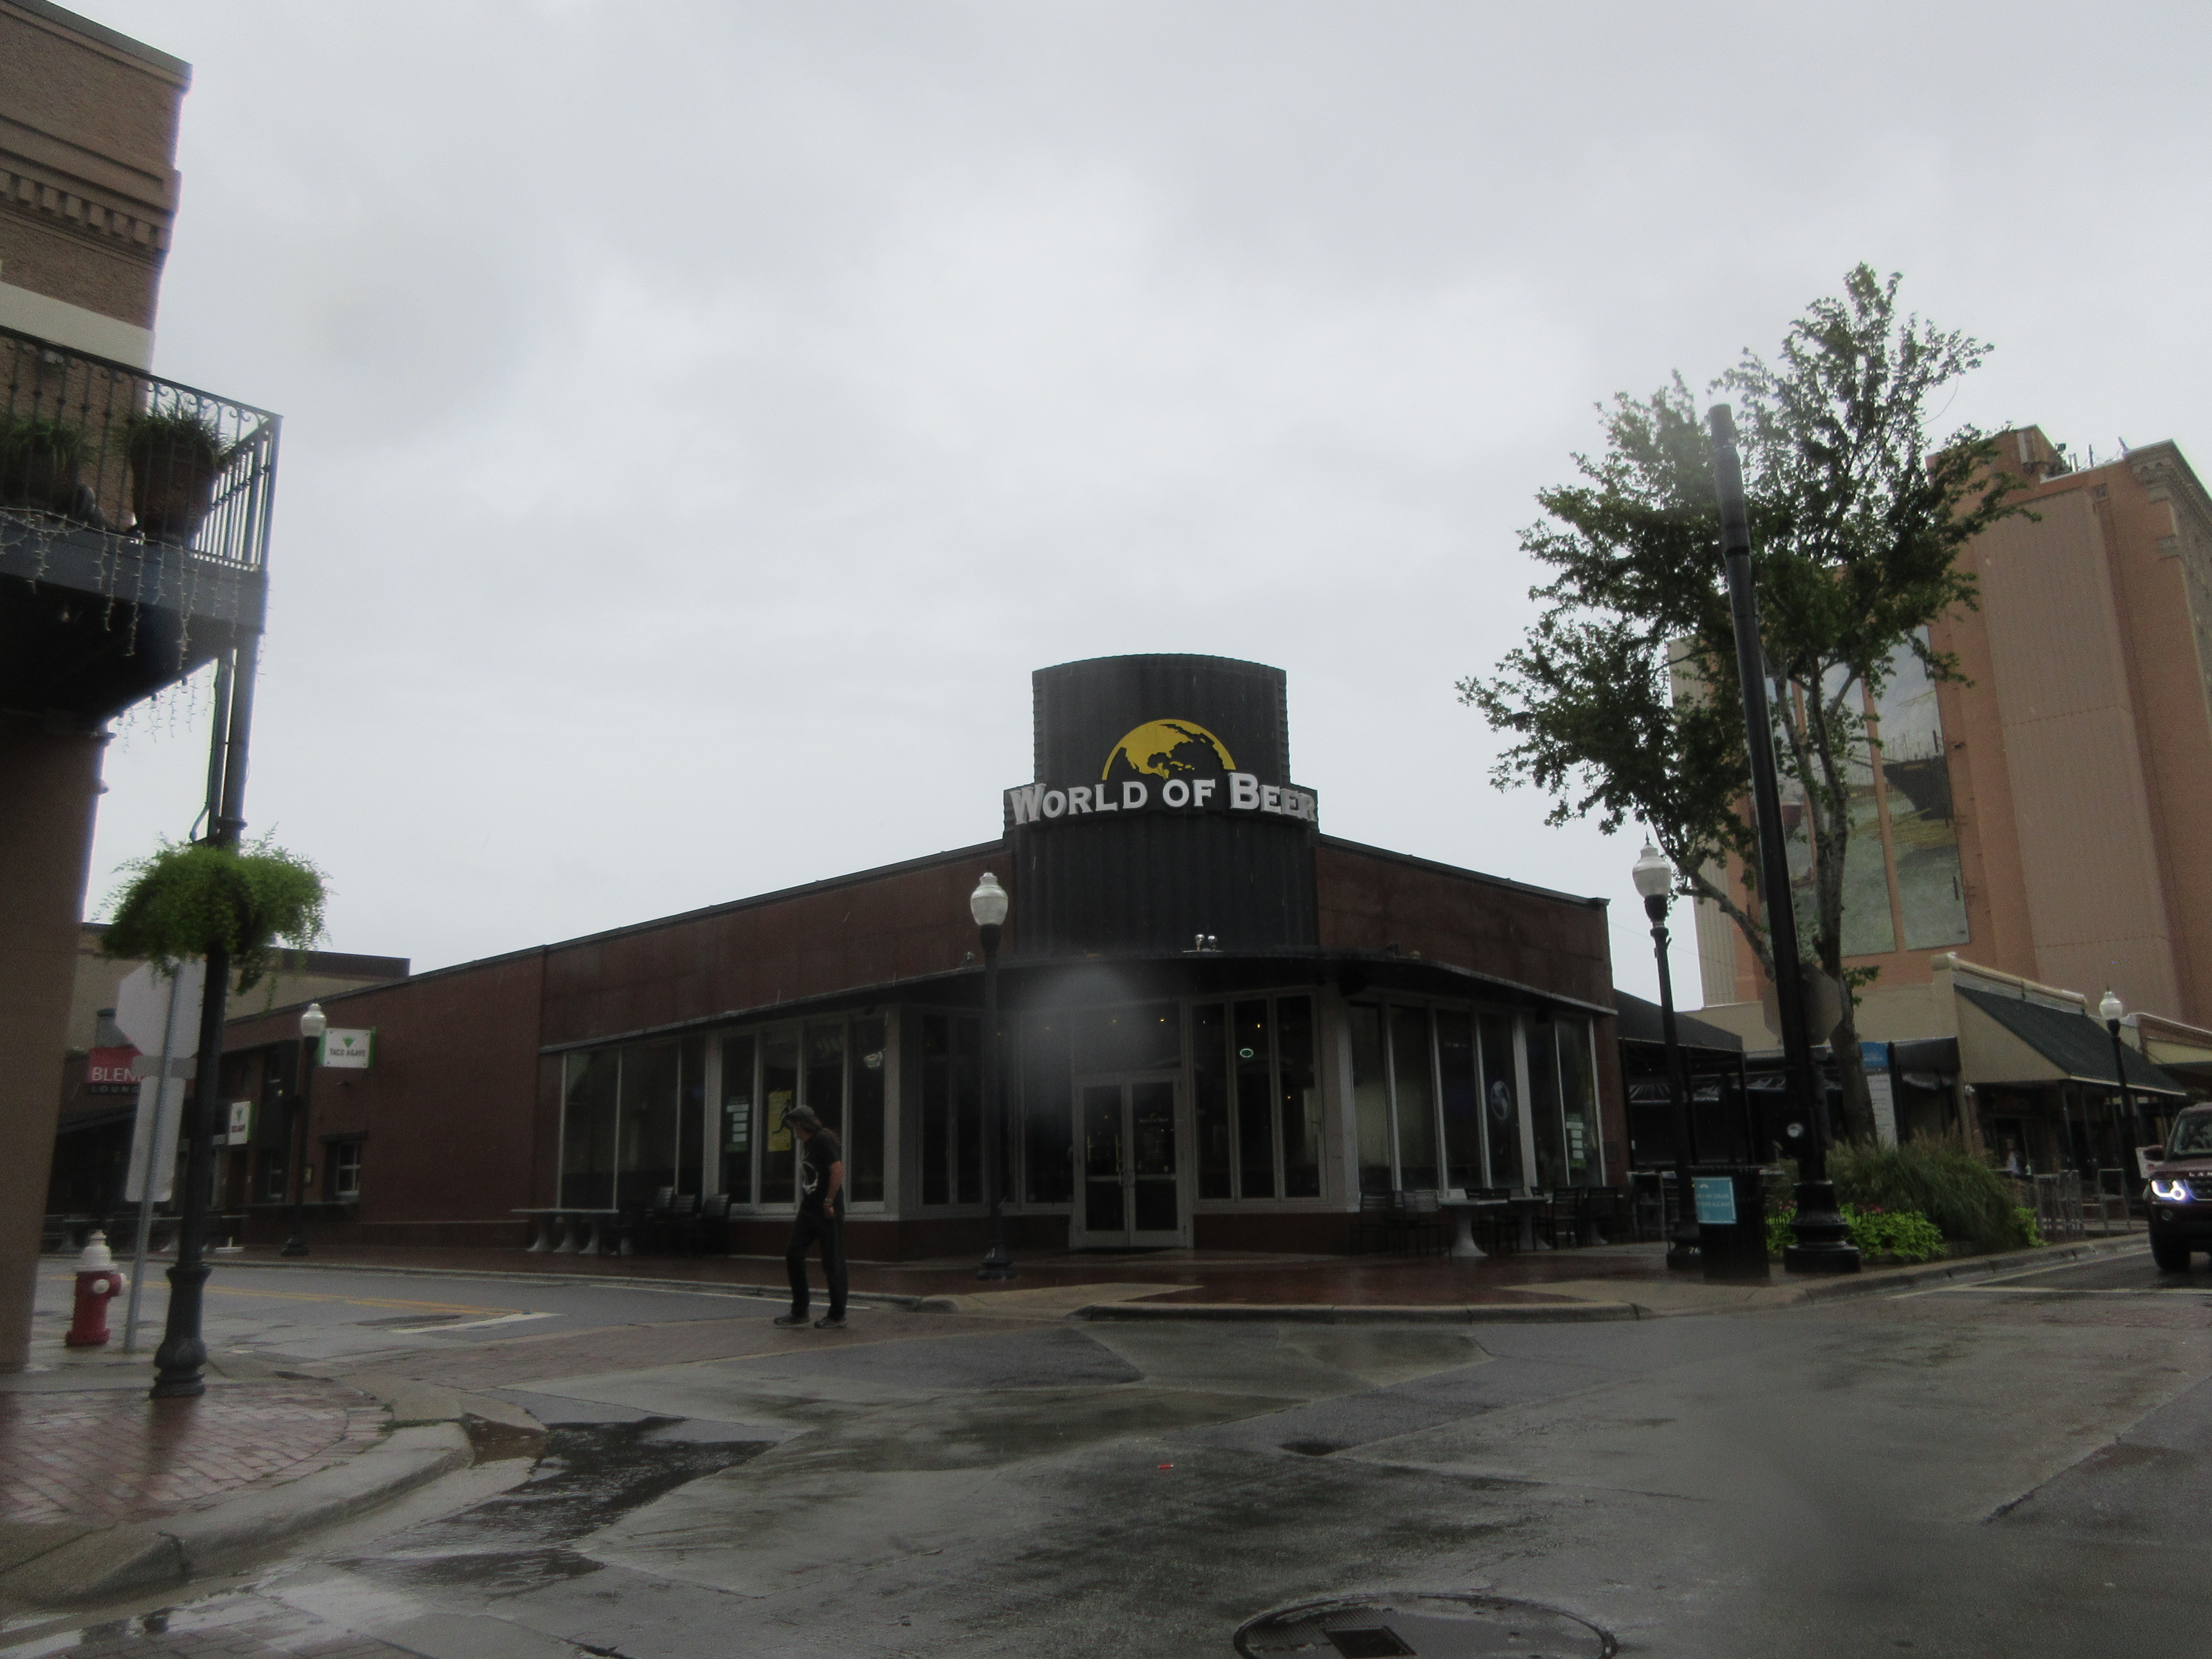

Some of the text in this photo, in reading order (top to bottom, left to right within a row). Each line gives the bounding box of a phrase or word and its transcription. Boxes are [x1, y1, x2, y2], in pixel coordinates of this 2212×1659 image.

[1011, 772, 1318, 825] WORLD OF BEER
